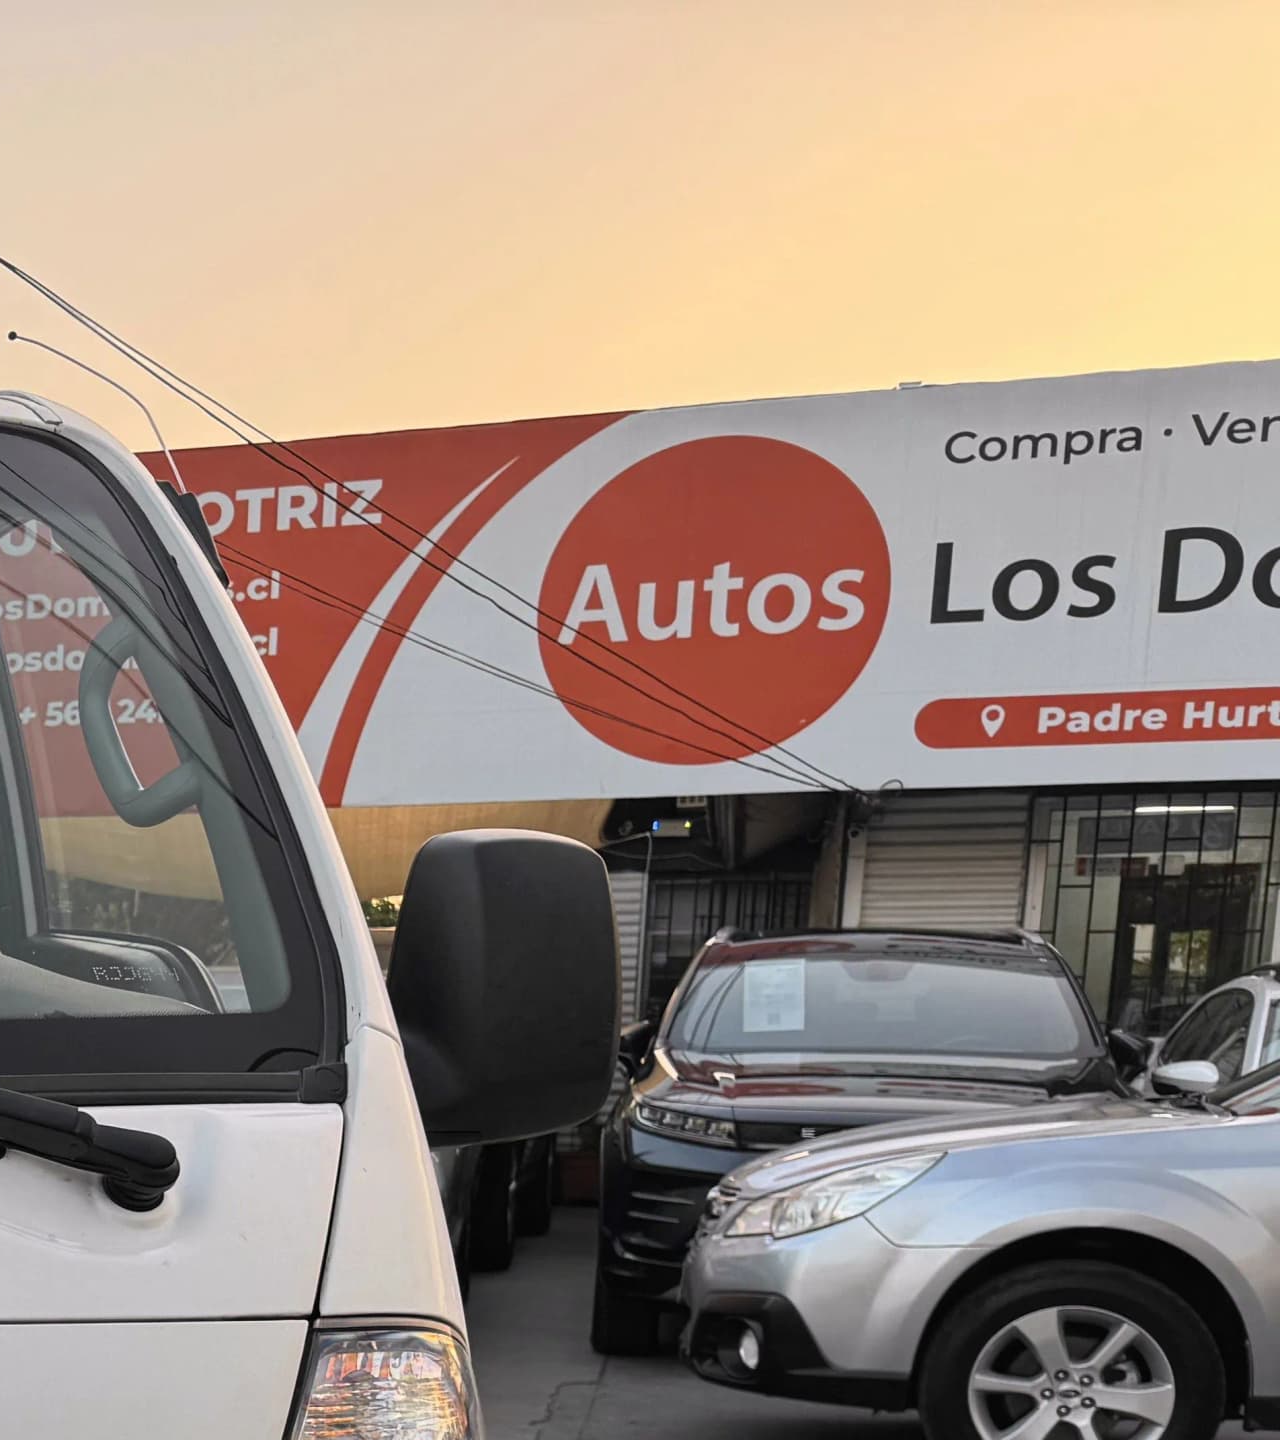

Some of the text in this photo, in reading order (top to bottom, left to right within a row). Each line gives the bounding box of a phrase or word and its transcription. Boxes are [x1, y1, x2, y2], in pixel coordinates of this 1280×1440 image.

[944, 425, 1144, 464] Compra
[930, 541, 1117, 624] Los
[557, 561, 866, 646] Autos
[117, 699, 164, 724] 24
[1037, 703, 1168, 734] Padre
